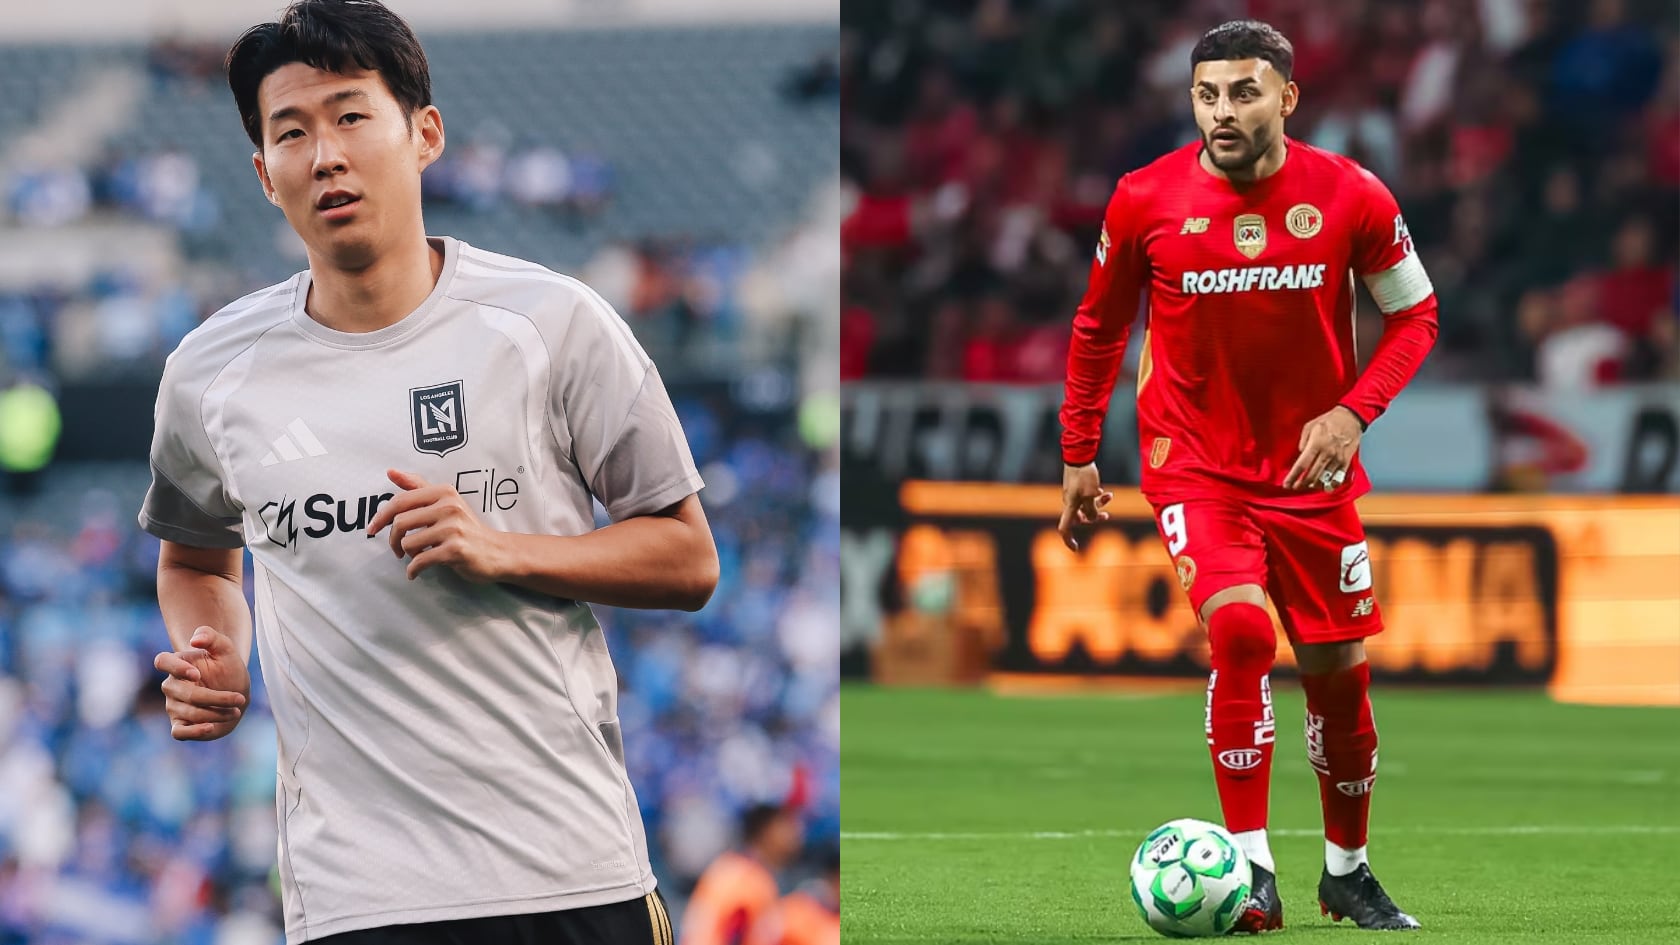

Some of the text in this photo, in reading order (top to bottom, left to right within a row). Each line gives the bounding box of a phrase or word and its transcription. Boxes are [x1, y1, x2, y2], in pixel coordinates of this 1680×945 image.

[1182, 264, 1326, 294] ROSHFRANS
[303, 493, 396, 539] Sup
[1161, 503, 1188, 557] 9
